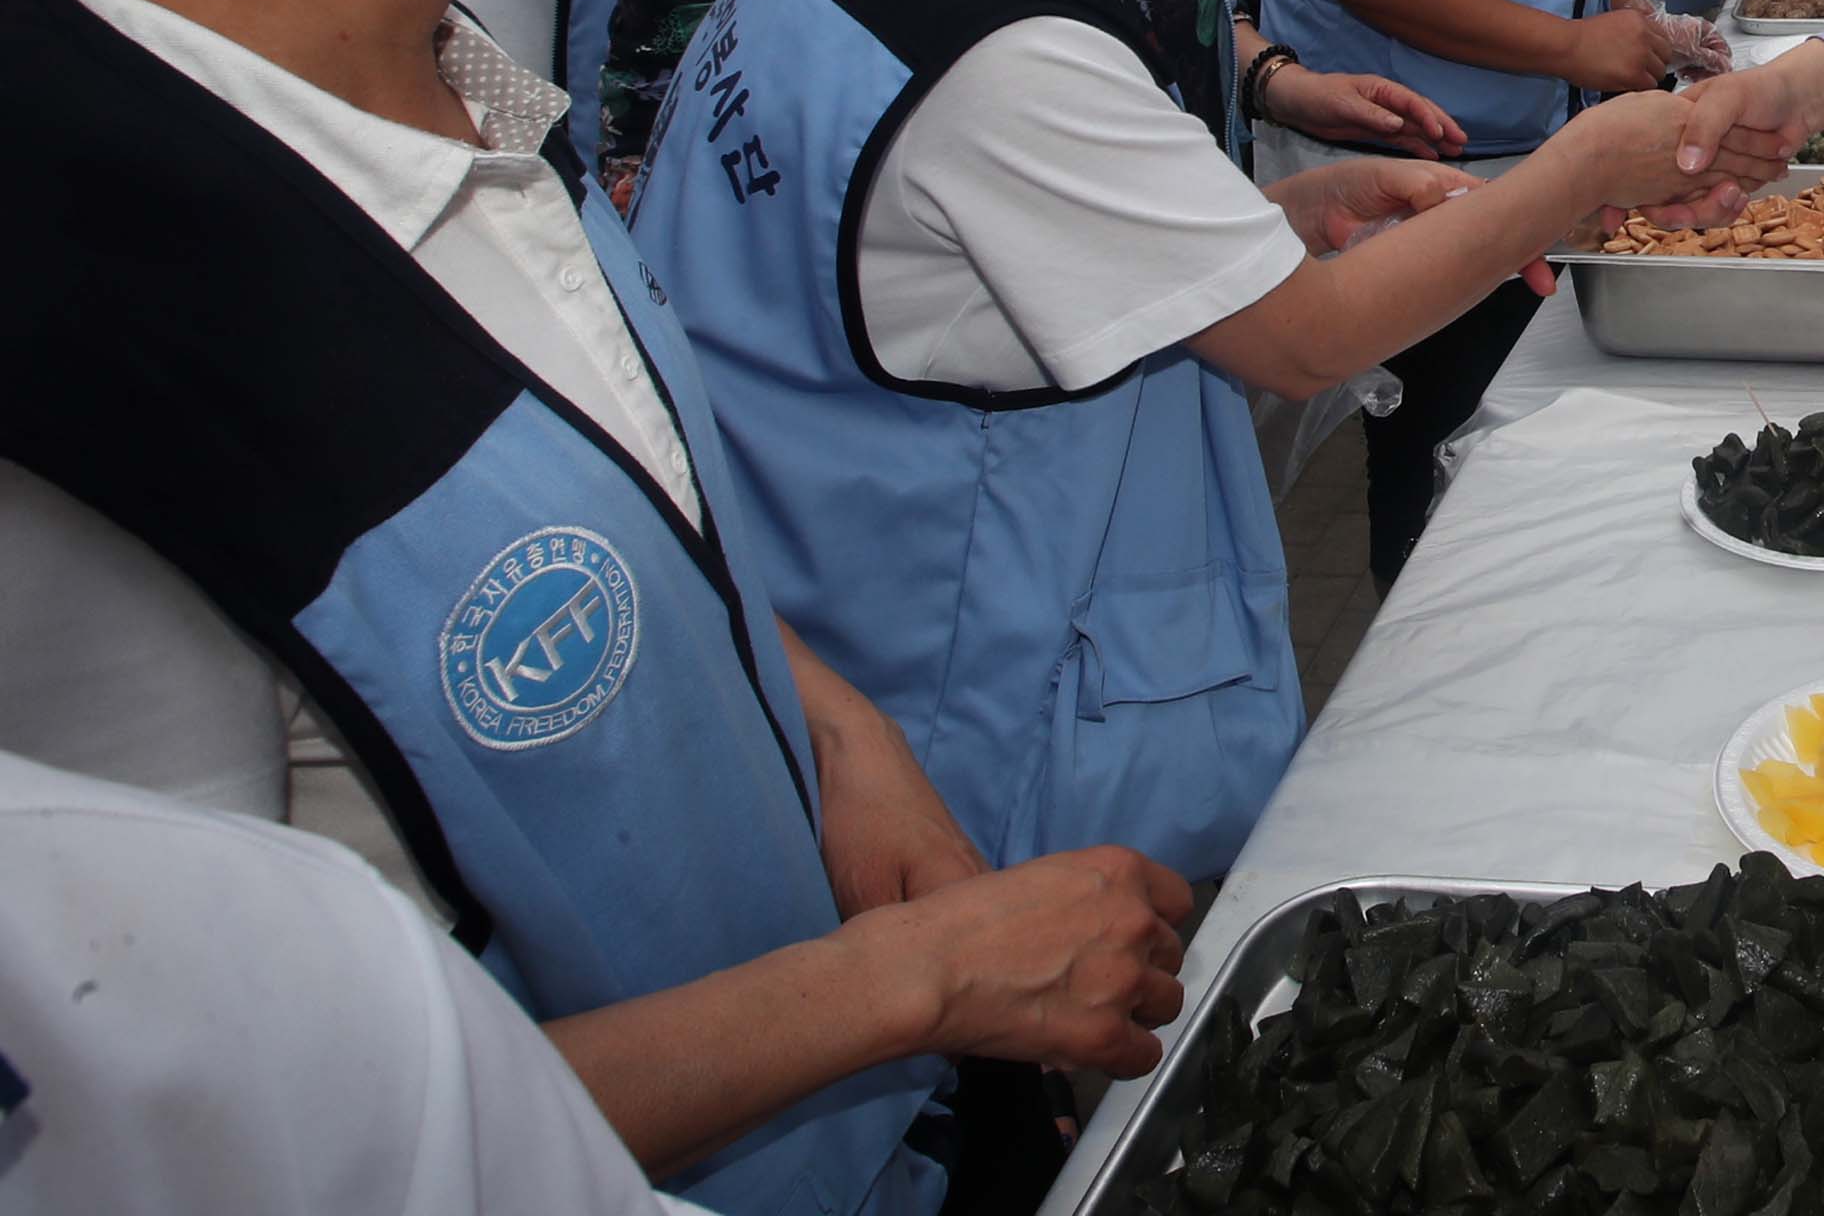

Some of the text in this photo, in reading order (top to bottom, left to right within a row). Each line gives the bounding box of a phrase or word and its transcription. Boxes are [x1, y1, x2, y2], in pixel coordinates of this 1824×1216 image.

[450, 537, 588, 656] 한국자유총연맹
[457, 556, 638, 737] KOREA FREEDOM FEDERATION
[486, 580, 606, 702] KFF
